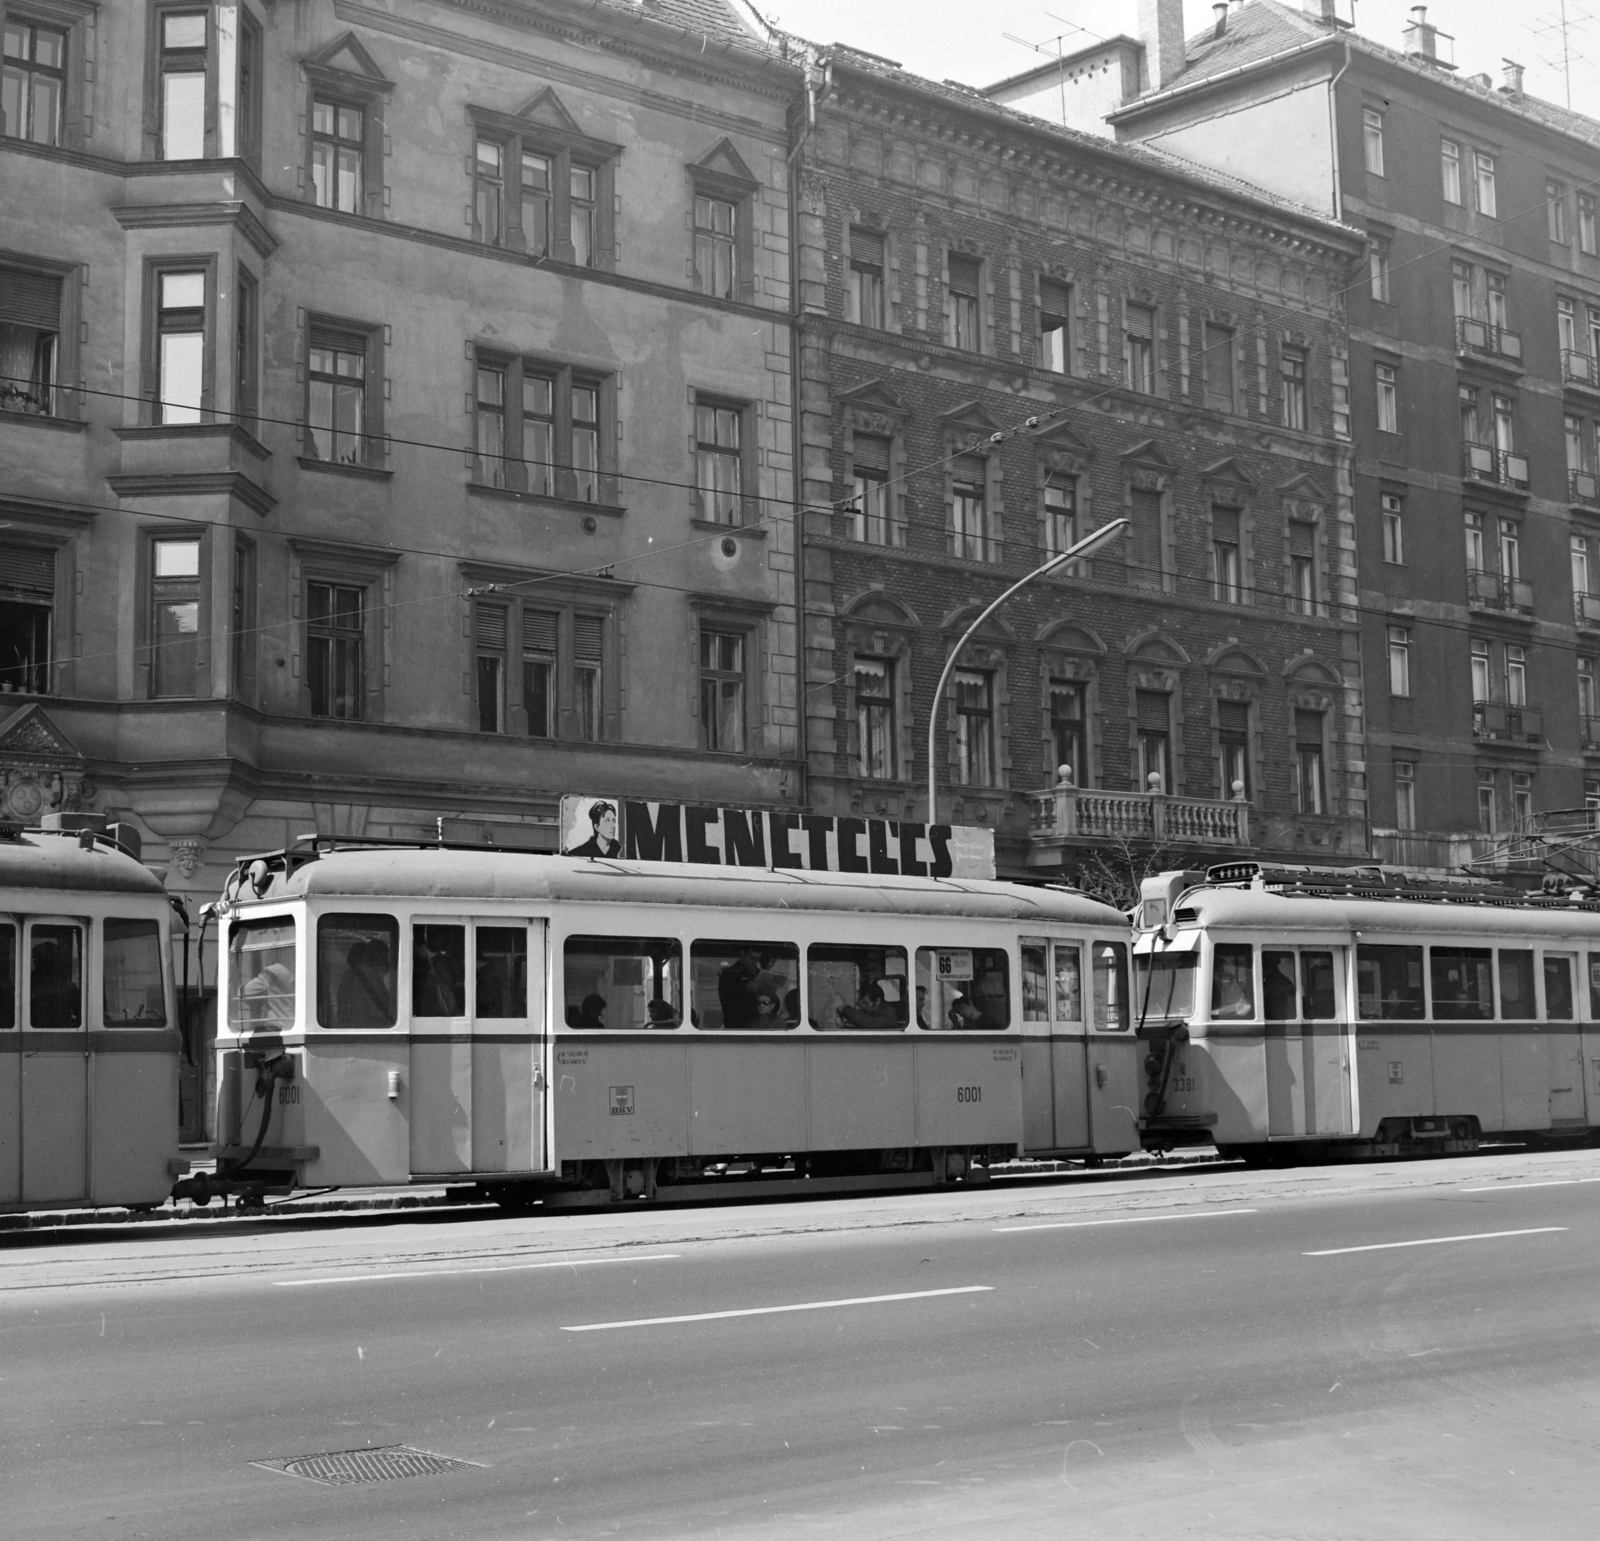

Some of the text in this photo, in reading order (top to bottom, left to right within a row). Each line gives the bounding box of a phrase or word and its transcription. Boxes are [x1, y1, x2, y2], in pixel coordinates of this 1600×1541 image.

[939, 956, 951, 974] 66
[1173, 1078, 1195, 1092] 3381
[279, 1085, 300, 1105] 6001
[957, 1086, 981, 1103] 6001
[611, 1106, 633, 1114] BKV
